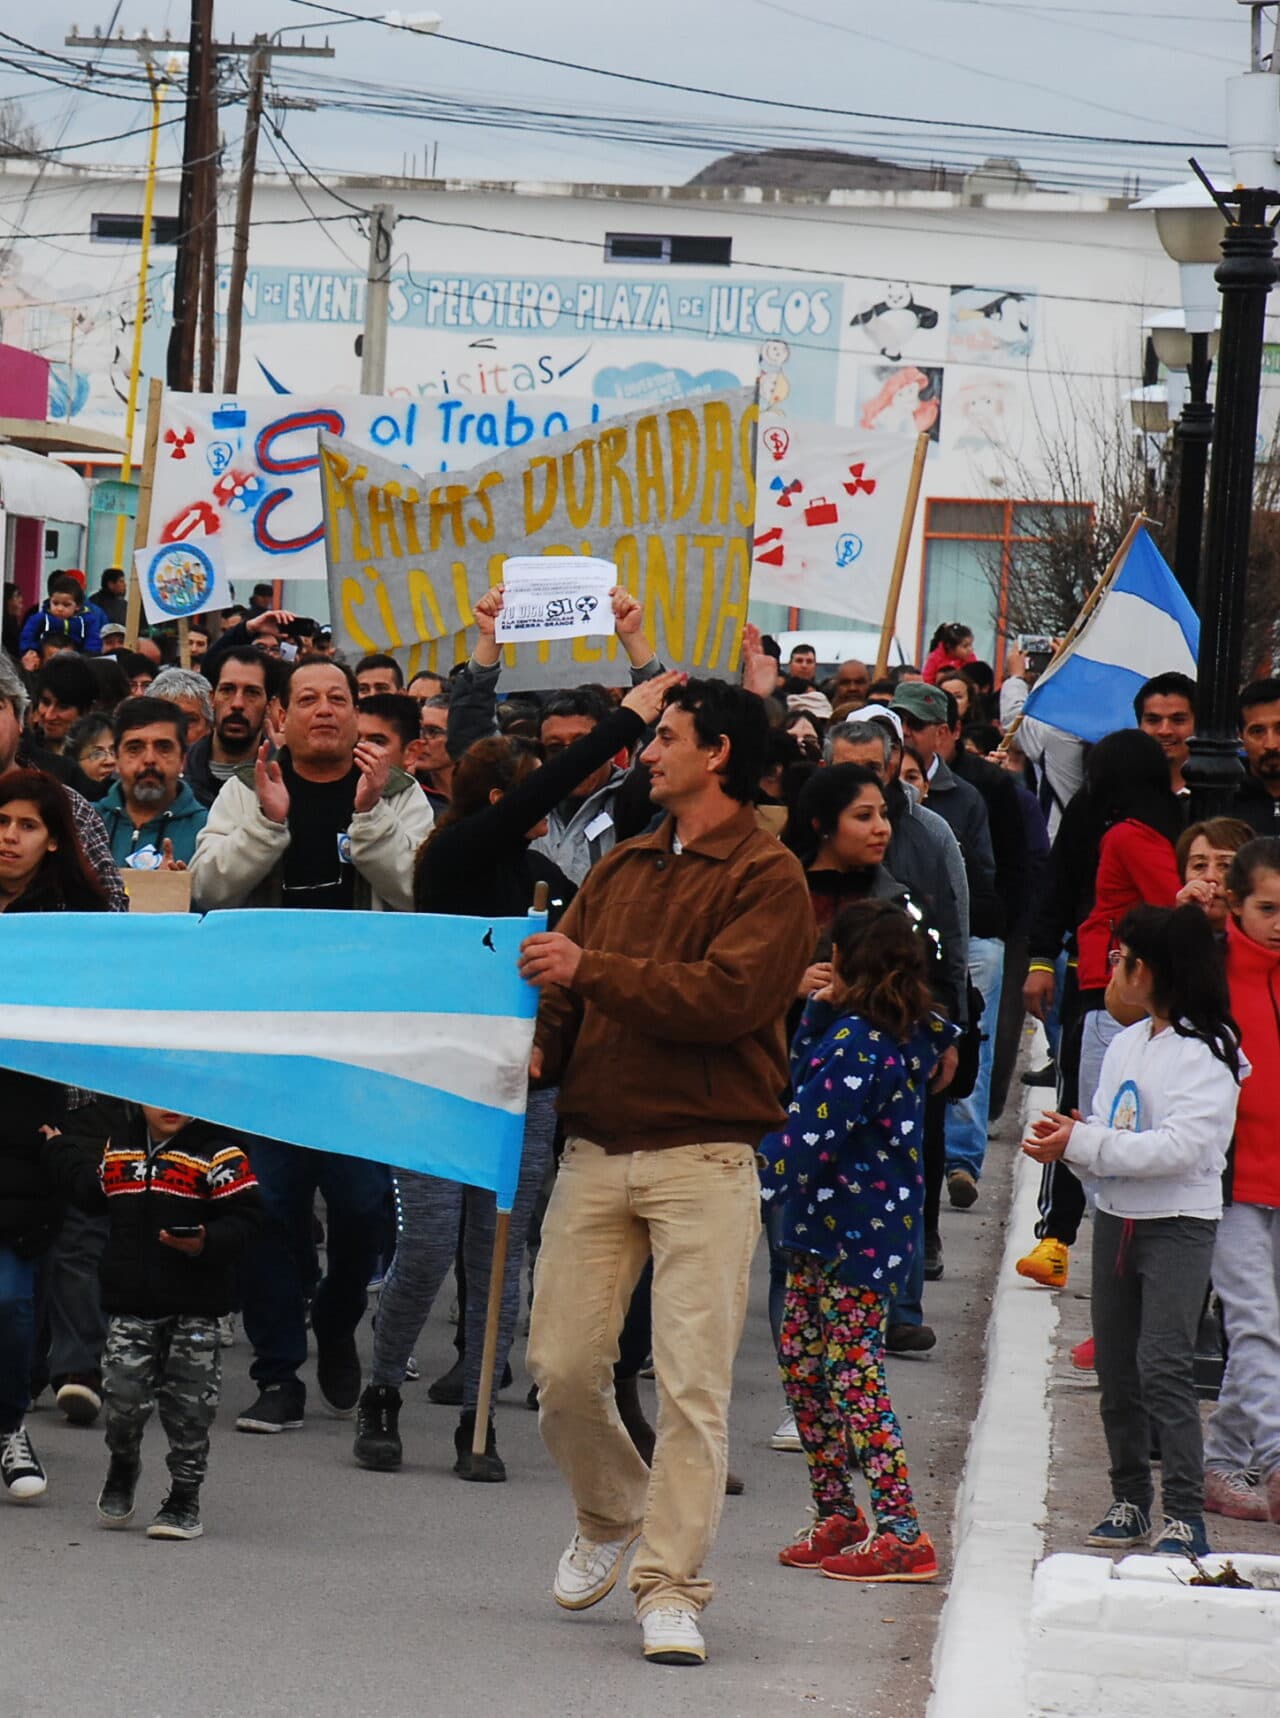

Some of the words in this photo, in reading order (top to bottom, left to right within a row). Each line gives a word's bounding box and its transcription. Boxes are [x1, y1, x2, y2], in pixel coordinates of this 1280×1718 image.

[264, 284, 283, 304] DE
[286, 273, 408, 321] EVENTS
[426, 279, 561, 329] PELOTERO
[575, 283, 675, 333] PLAZA
[678, 297, 704, 317] DE
[706, 286, 832, 339] JUEGOS
[523, 401, 759, 536] DORADAS
[546, 598, 574, 618] SI
